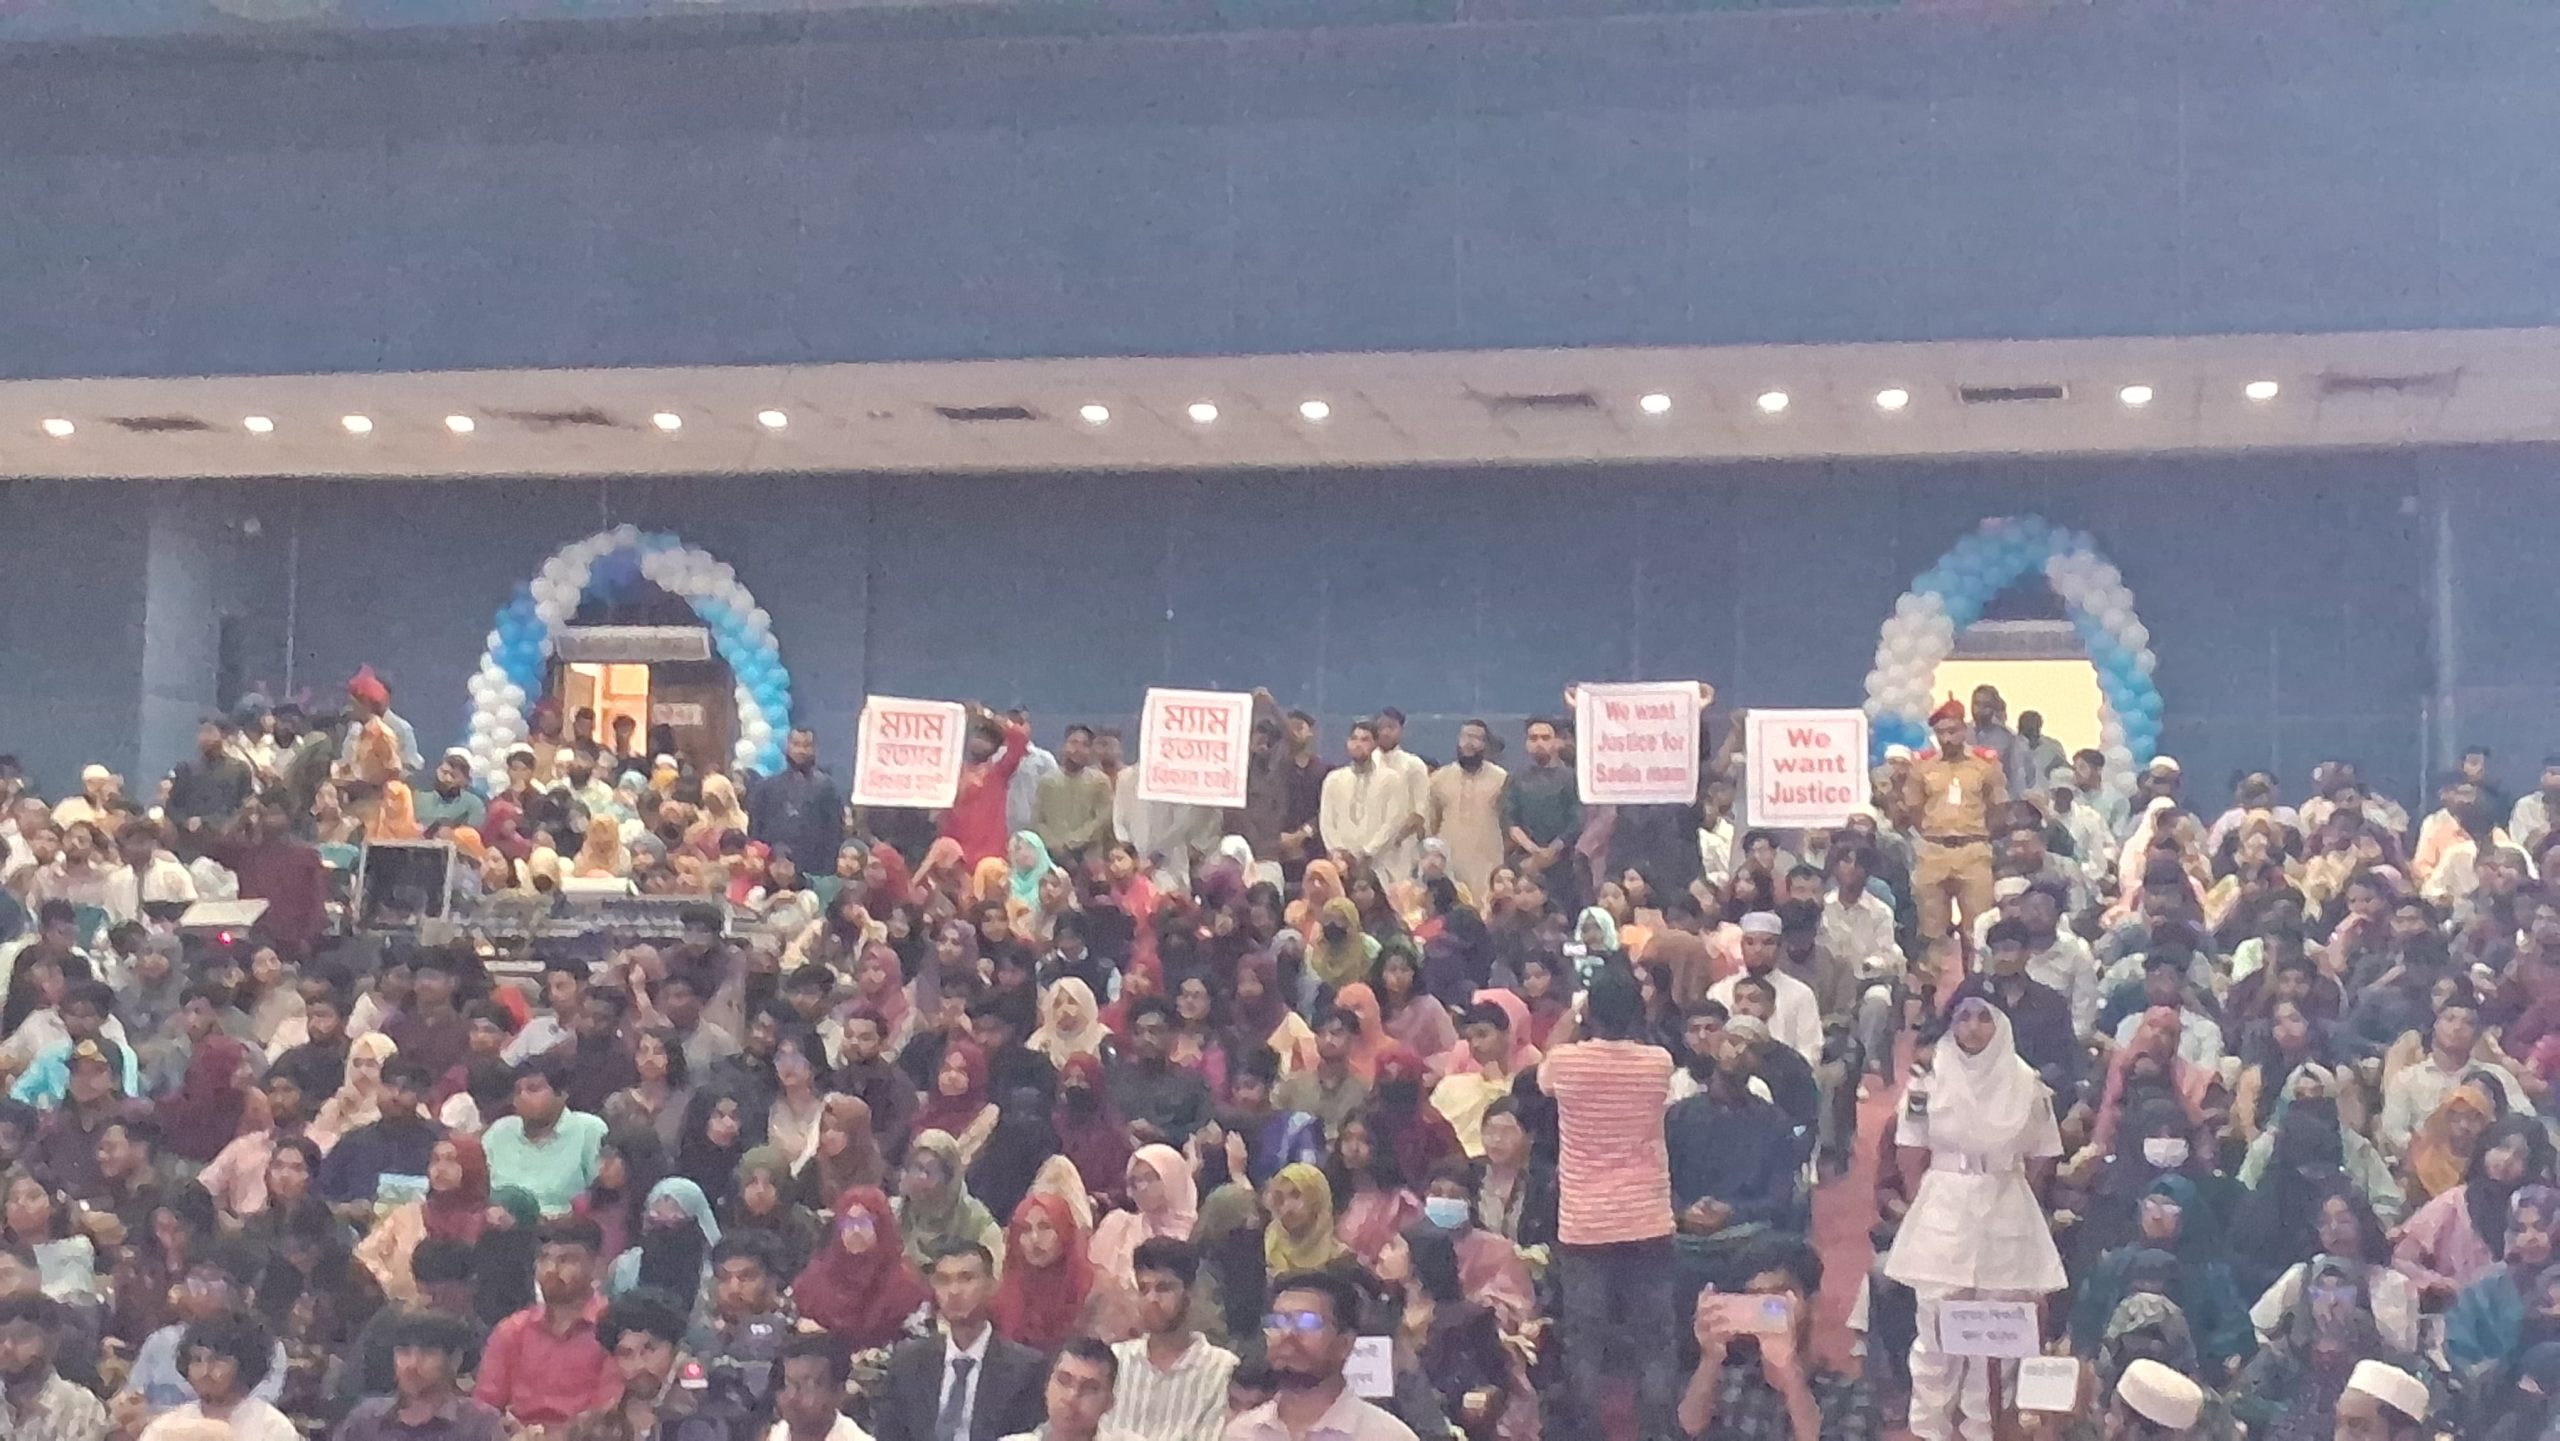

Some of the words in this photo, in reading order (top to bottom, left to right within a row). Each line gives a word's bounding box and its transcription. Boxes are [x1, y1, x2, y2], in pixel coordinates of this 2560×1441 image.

[1164, 704, 1229, 735] ম্যাম
[1605, 702, 1630, 720] We
[1634, 701, 1676, 720] want
[880, 711, 946, 740] ম্যাম
[1597, 731, 1657, 752] Justice
[1662, 731, 1685, 752] for
[1787, 727, 1831, 748] We
[1160, 737, 1230, 764] হত্যার
[1773, 754, 1847, 773] want
[1766, 780, 1851, 805] Justice
